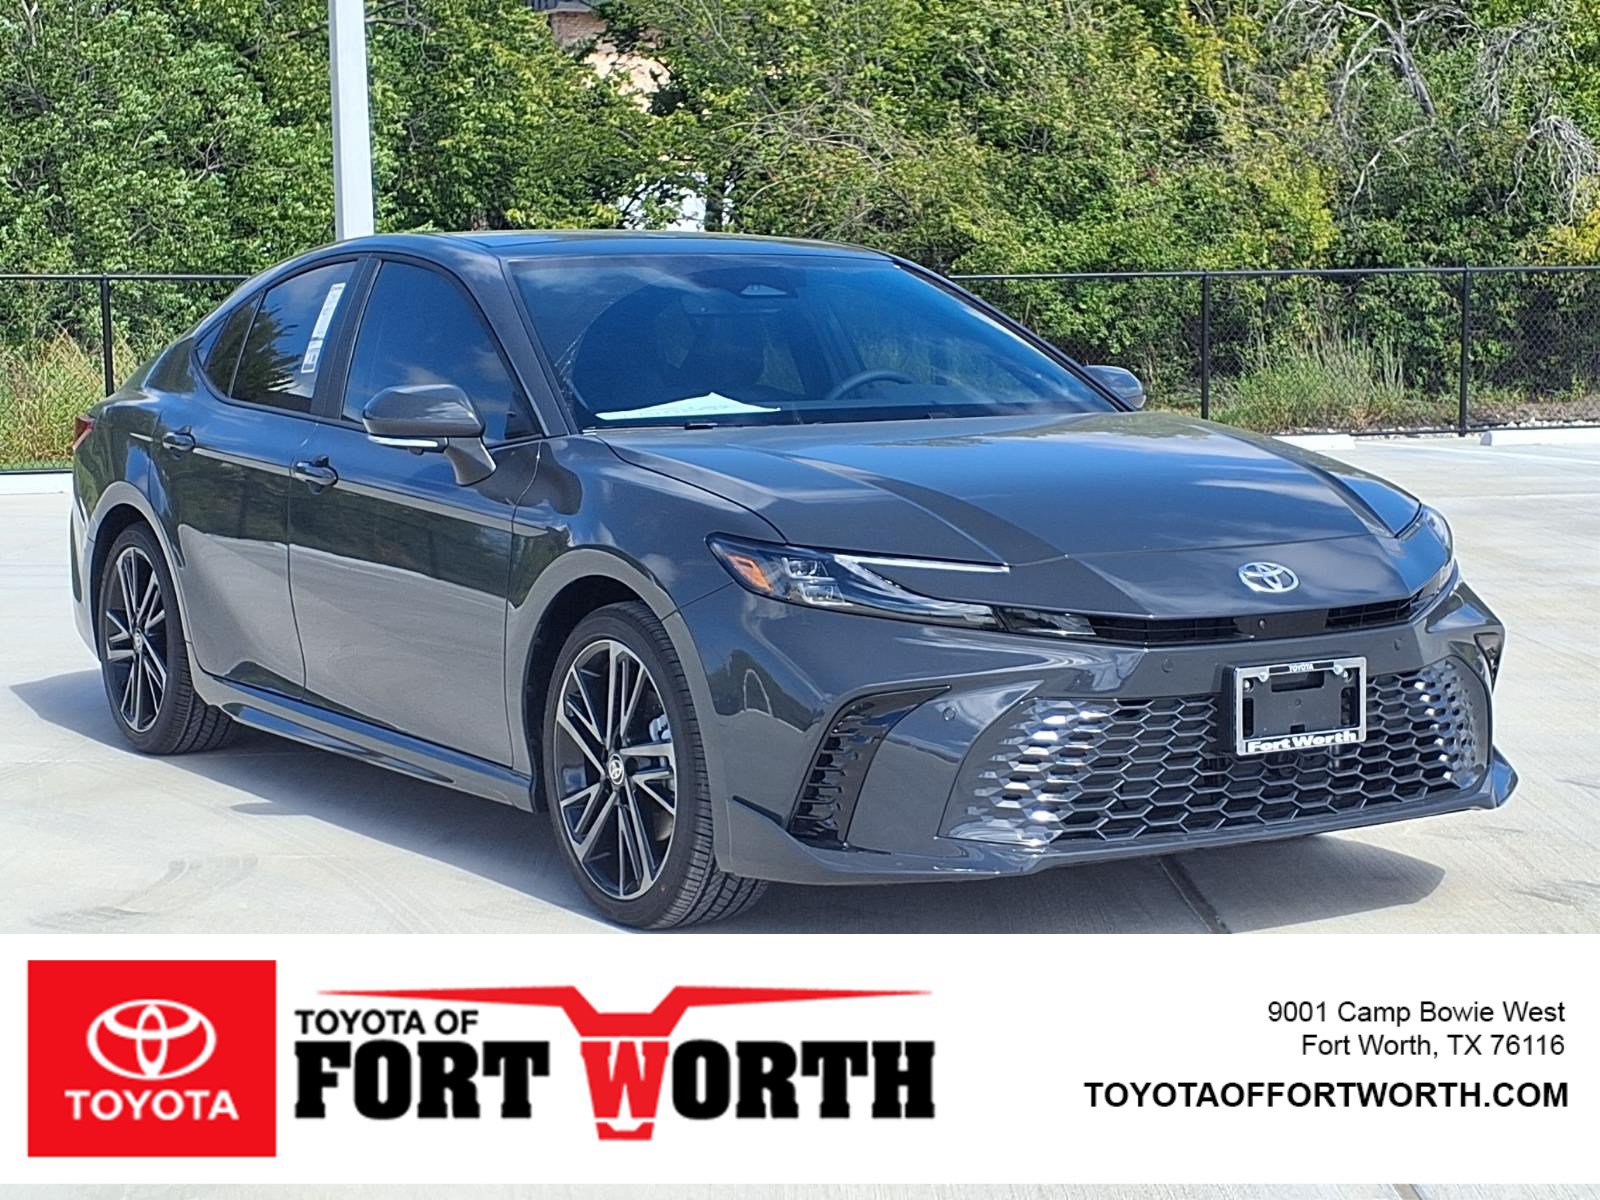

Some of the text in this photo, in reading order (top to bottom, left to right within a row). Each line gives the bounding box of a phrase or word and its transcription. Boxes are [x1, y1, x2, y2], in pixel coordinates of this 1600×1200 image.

[1288, 663, 1314, 672] TOYOTA
[1247, 730, 1357, 752] Fort Worth
